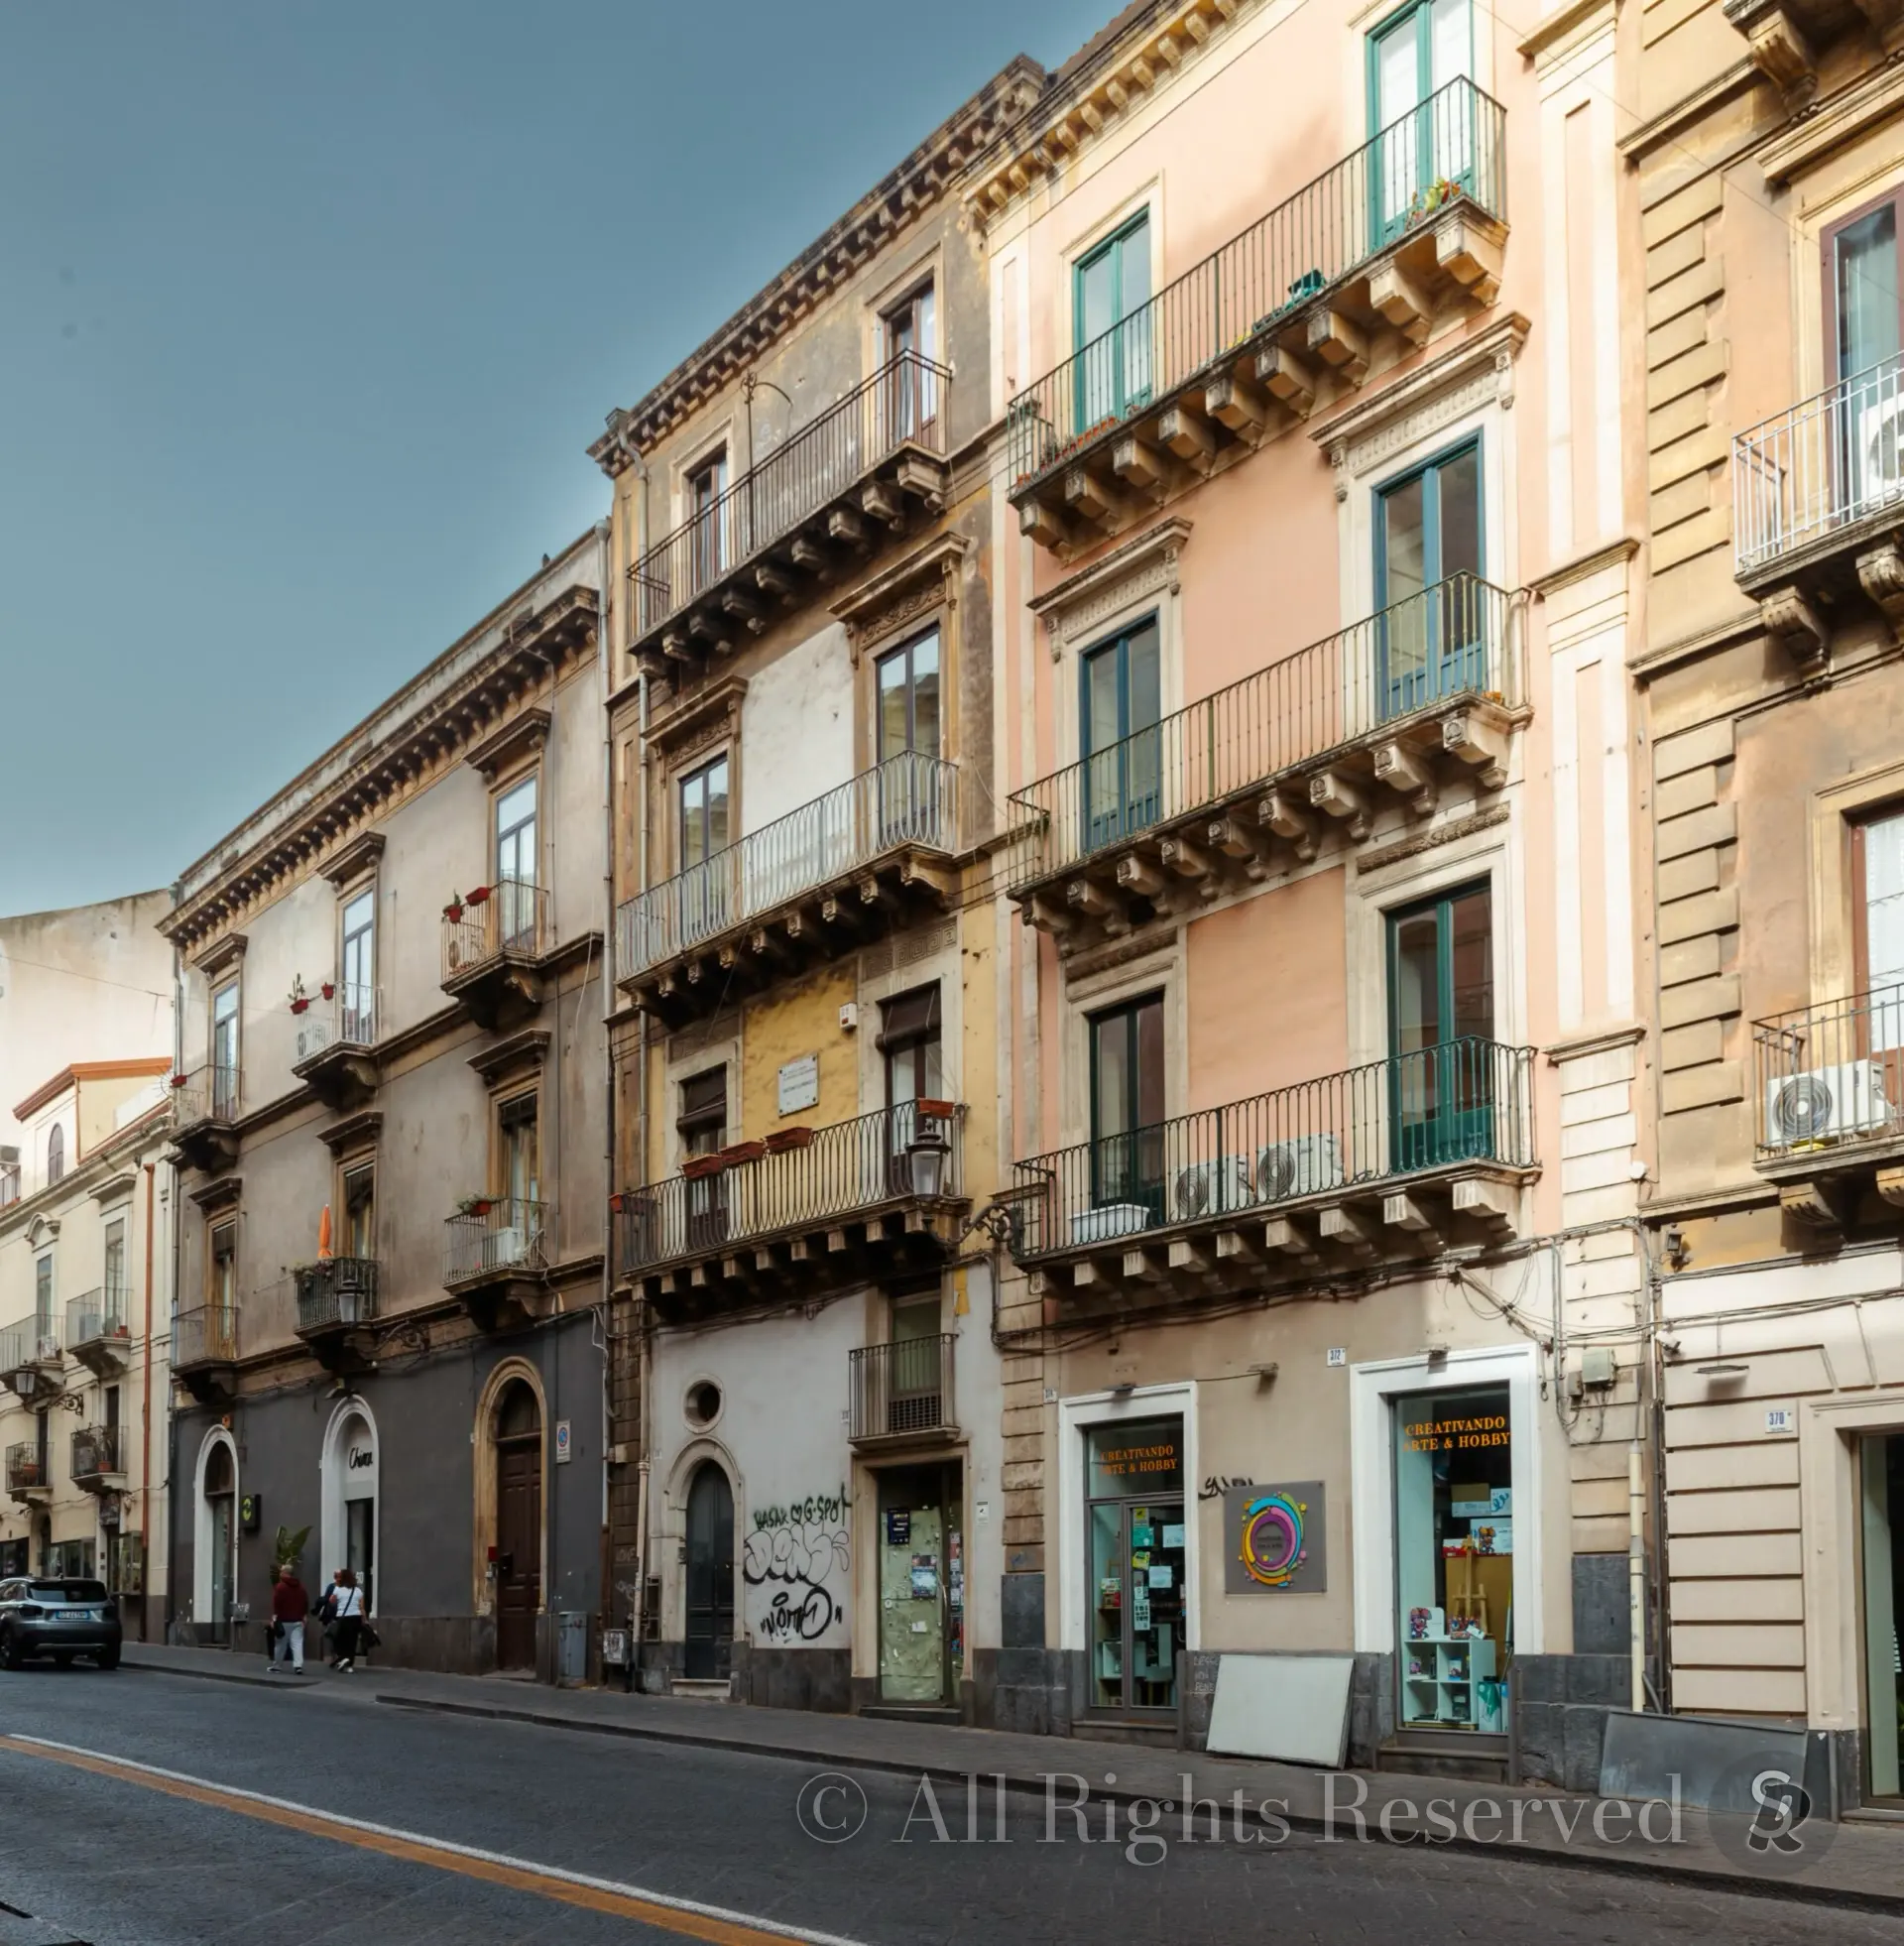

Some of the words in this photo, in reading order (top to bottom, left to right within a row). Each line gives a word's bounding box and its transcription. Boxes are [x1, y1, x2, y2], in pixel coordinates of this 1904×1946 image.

[1404, 1415, 1505, 1437] CREATIVANDO
[1768, 1411, 1785, 1425] 370
[1444, 1436, 1453, 1449] &
[1459, 1431, 1511, 1448] HOBBY
[1101, 1444, 1174, 1462] CREATIVANDO
[1101, 1463, 1127, 1476] RTE
[1139, 1458, 1178, 1473] HOBBY
